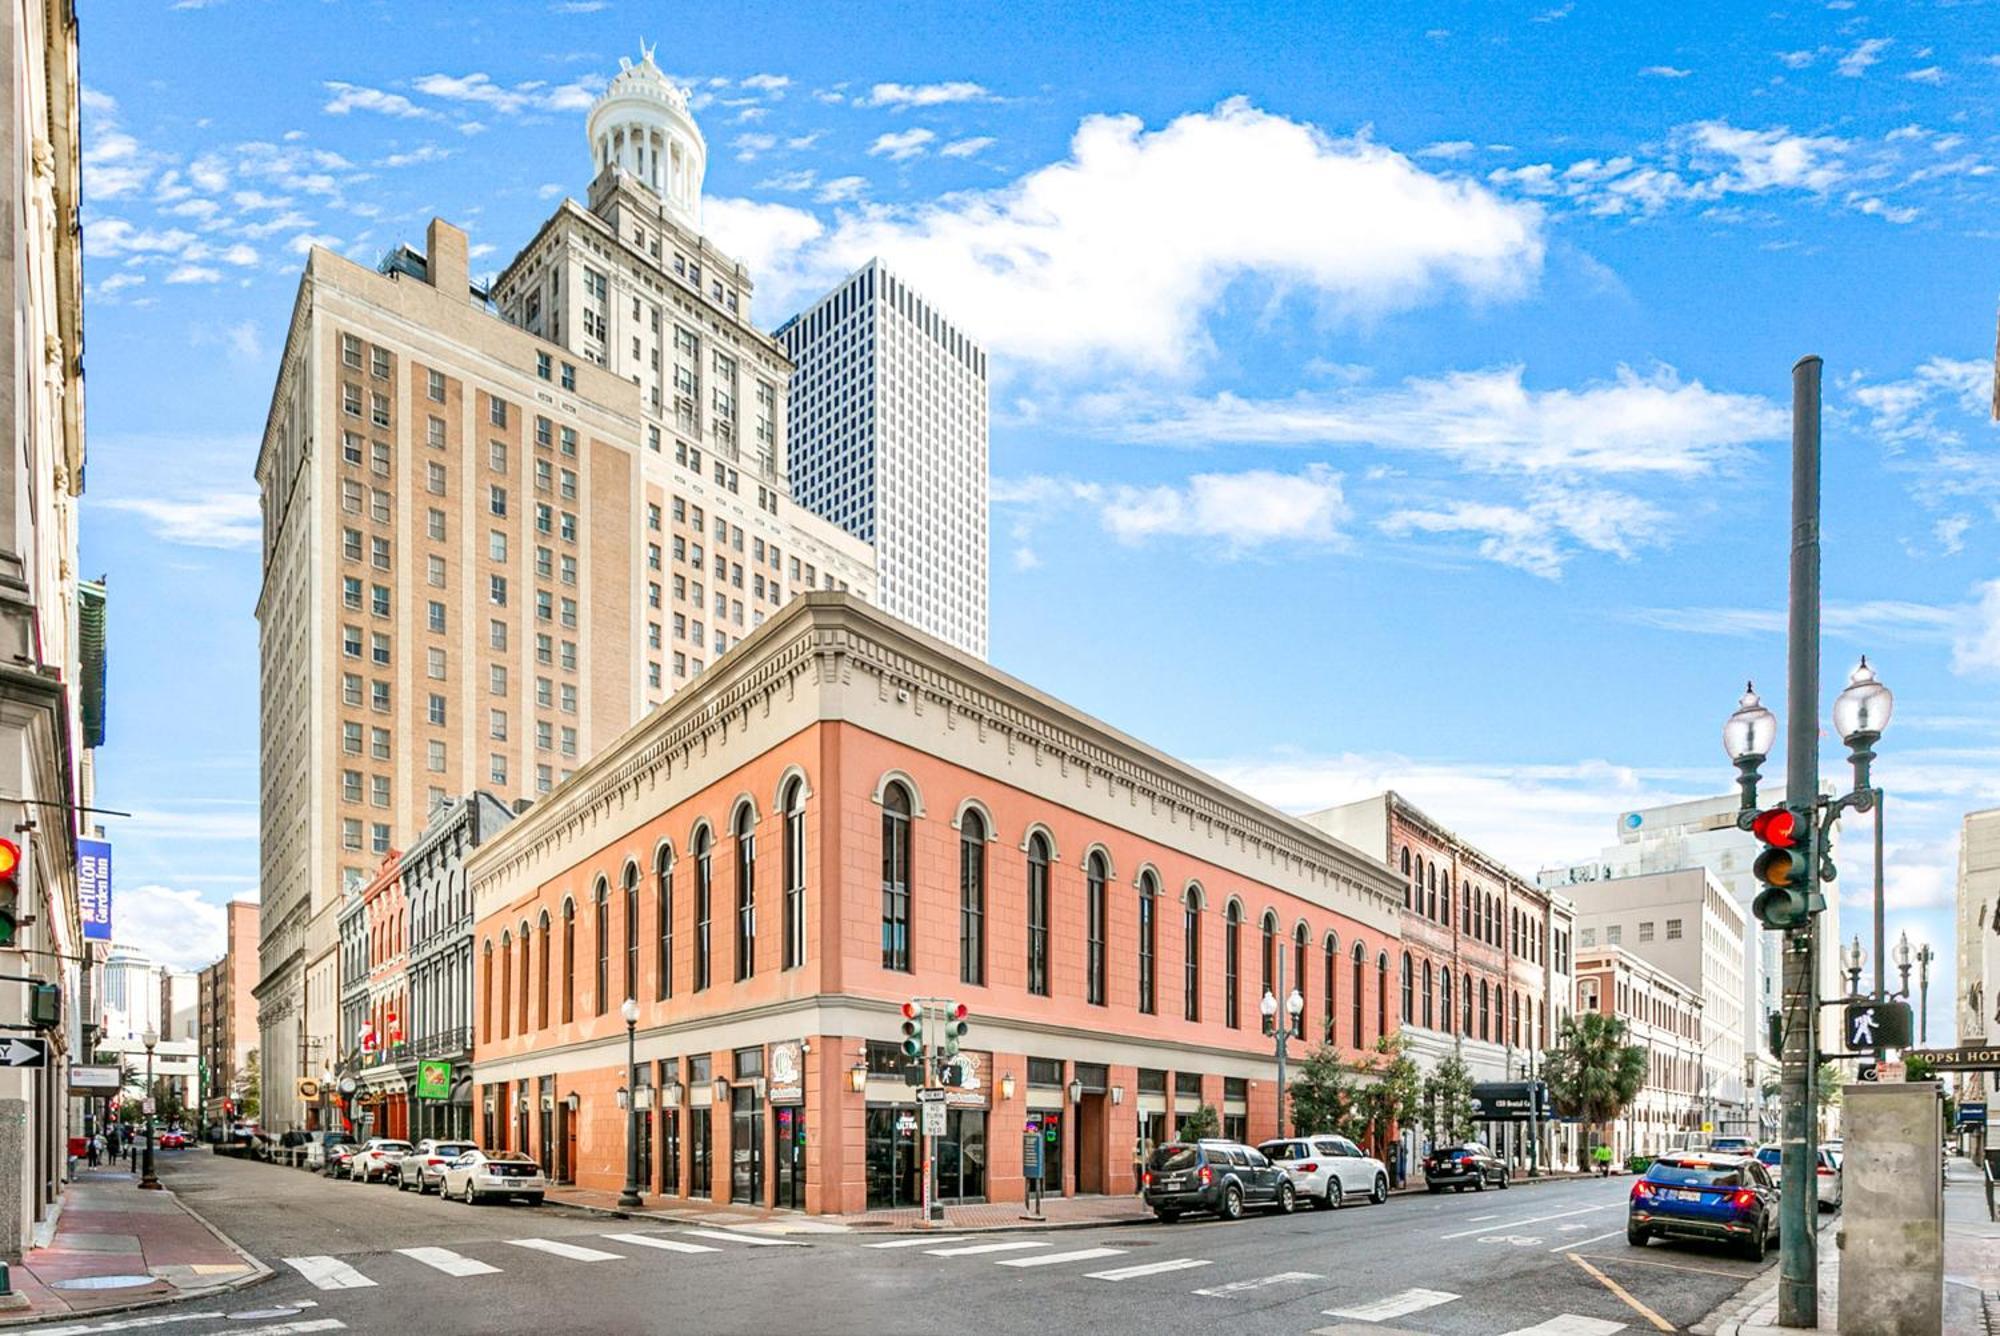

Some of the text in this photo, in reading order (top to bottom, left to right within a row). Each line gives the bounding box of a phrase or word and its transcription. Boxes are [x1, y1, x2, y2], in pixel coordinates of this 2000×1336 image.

[81, 856, 96, 910] Hilton
[96, 857, 108, 924] Garden Inn
